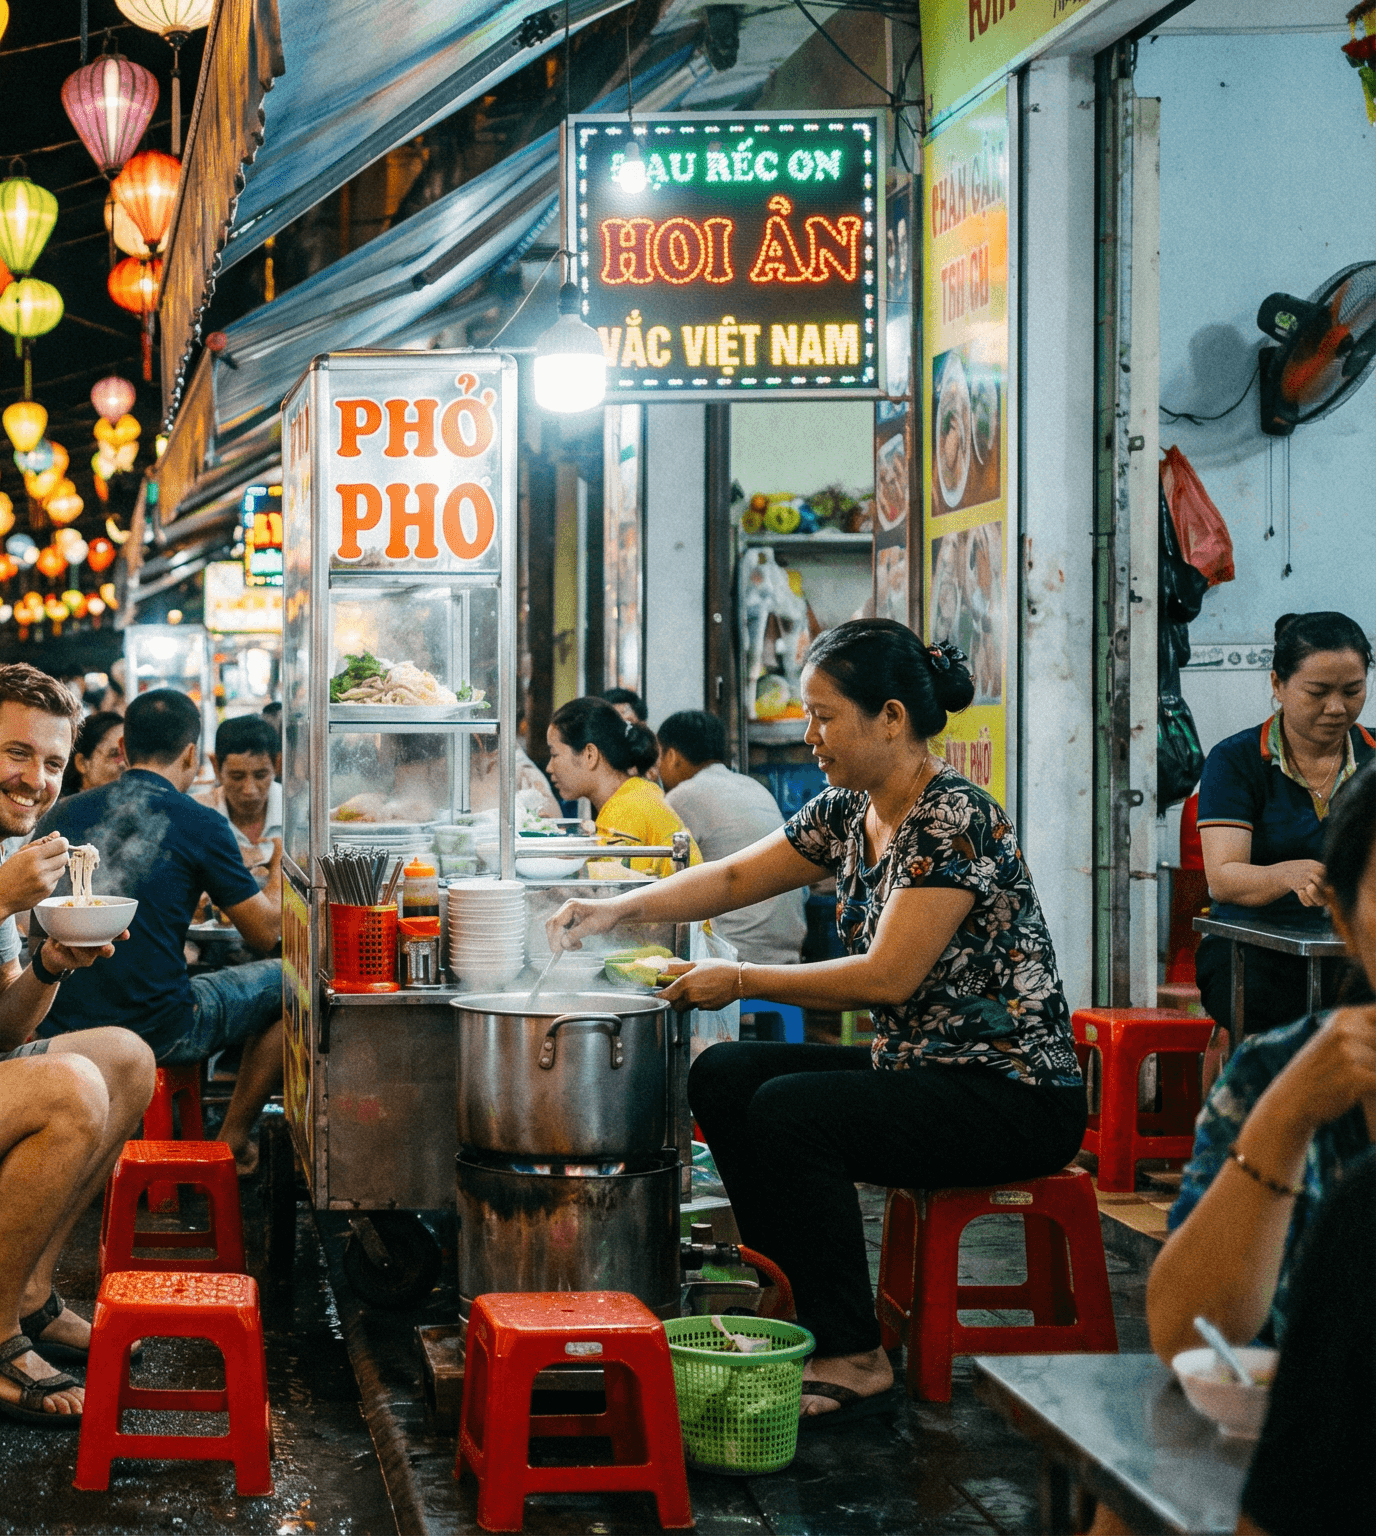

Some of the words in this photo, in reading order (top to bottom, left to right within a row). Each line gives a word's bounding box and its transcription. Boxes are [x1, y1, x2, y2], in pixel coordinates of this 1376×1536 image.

[787, 149, 842, 182] ON
[600, 217, 734, 284] HOI
[680, 315, 761, 376] VIỆT
[770, 323, 860, 366] NAM
[334, 372, 497, 458] PHỞ
[335, 482, 495, 560] PHO
